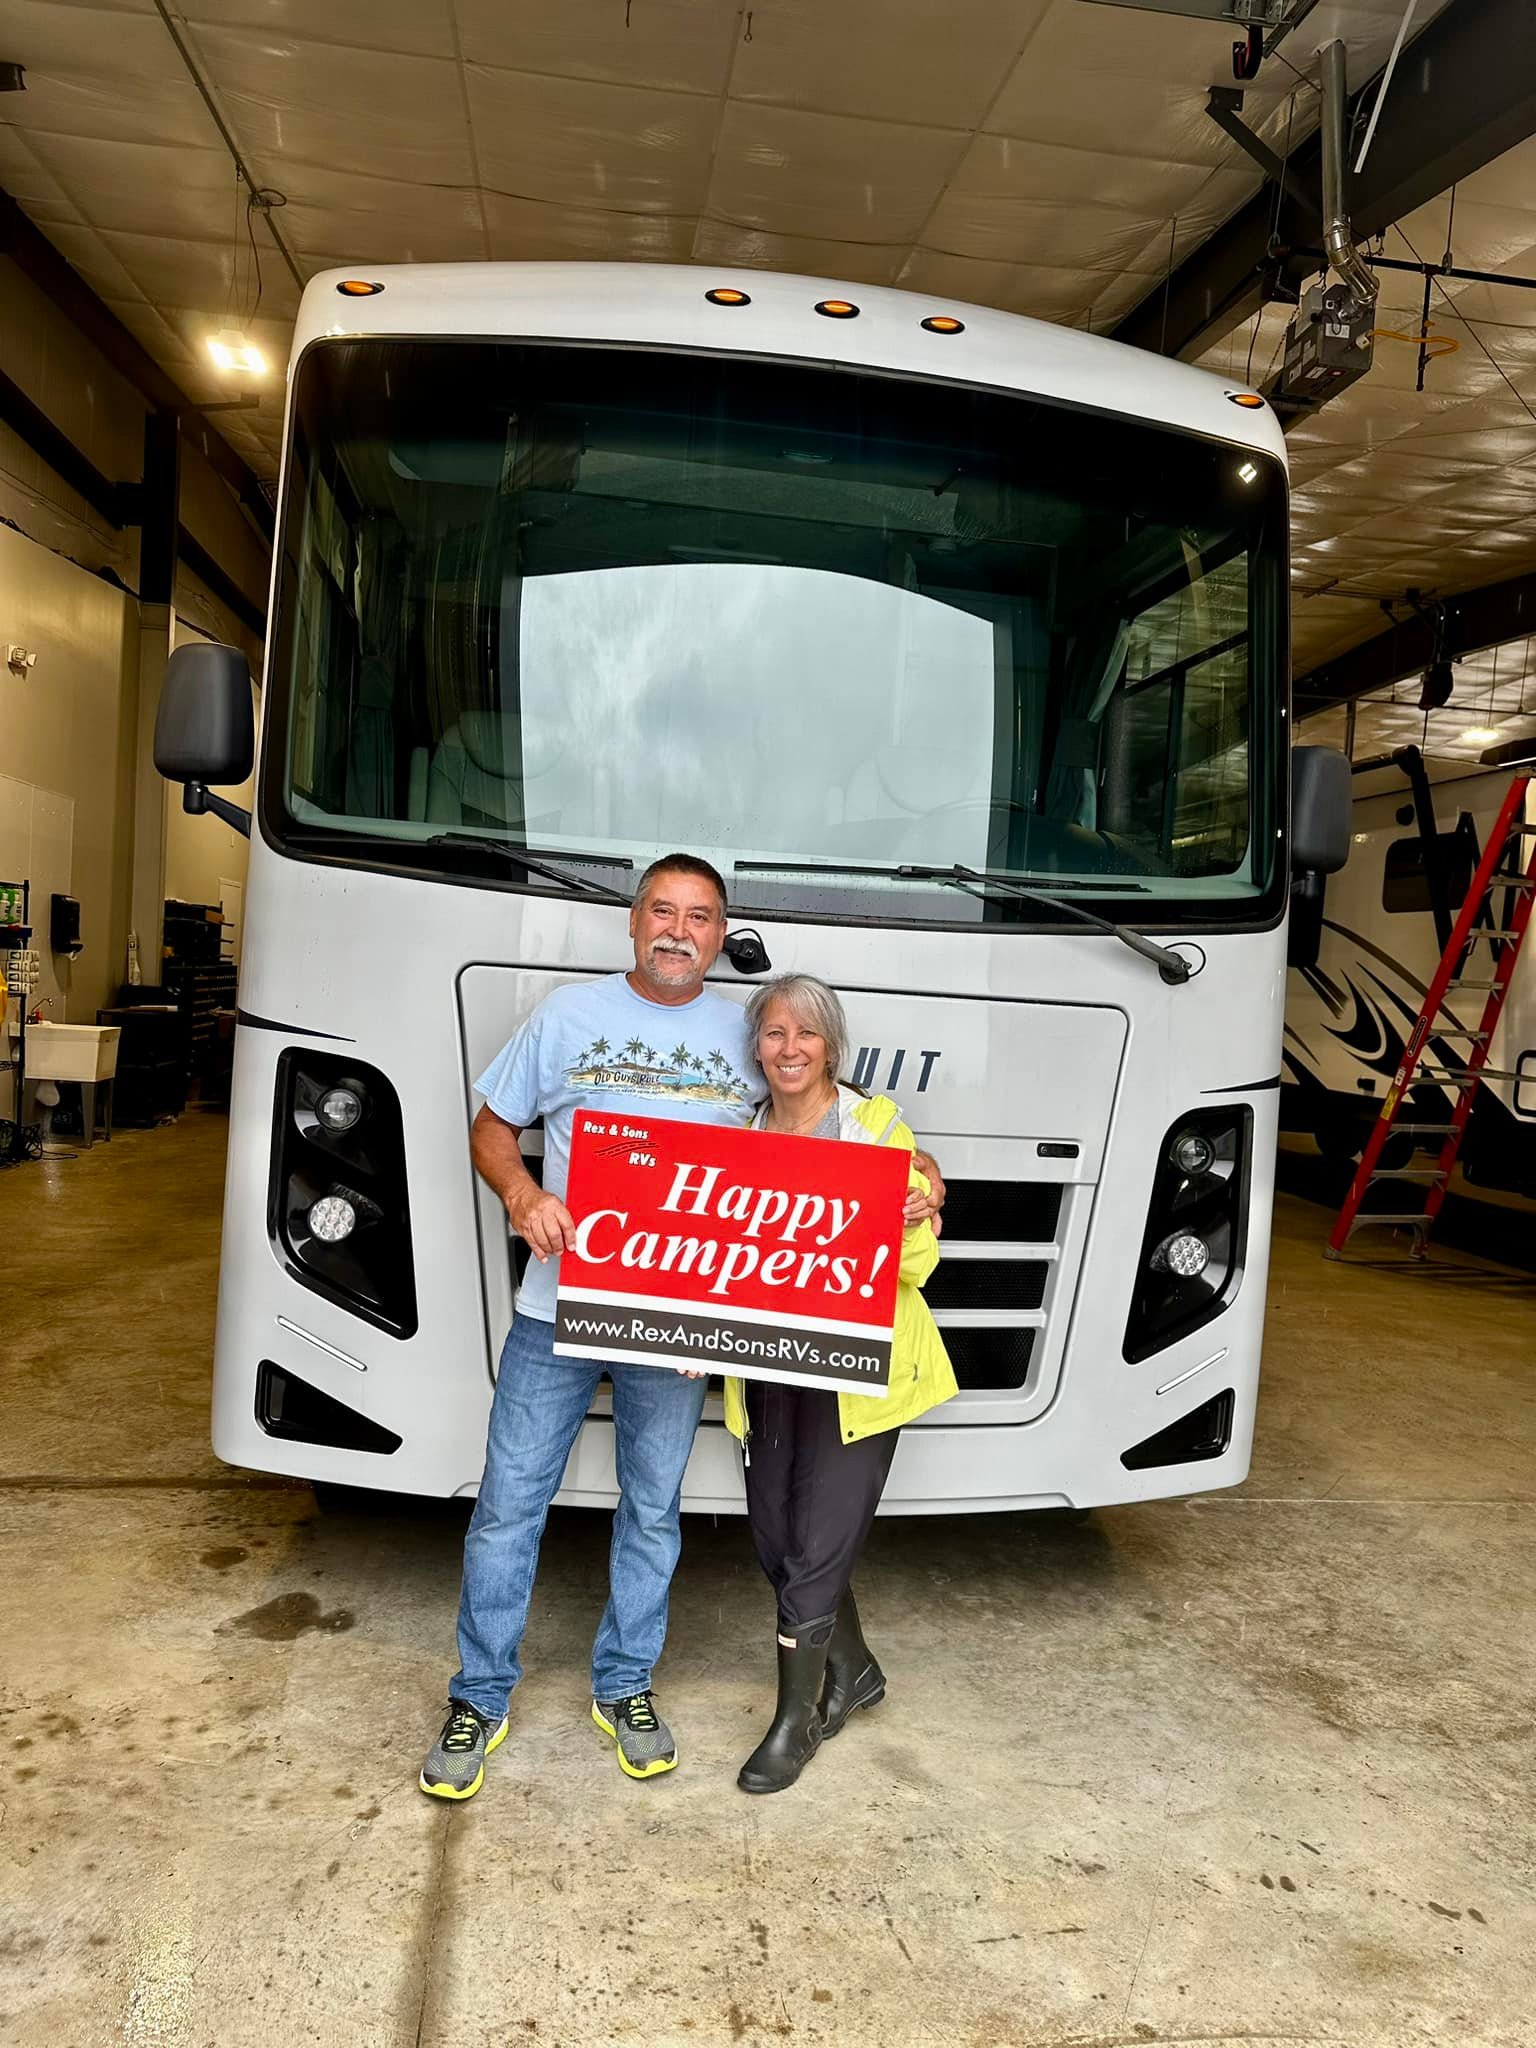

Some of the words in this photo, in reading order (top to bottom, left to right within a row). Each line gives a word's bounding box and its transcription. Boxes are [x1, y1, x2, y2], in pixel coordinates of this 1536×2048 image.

[583, 1121, 605, 1134] Rex
[609, 1124, 618, 1136] &
[621, 1126, 649, 1140] Sons
[628, 1152, 657, 1167] RVs
[657, 1162, 861, 1246] Happy
[575, 1209, 890, 1298] Campers!
[563, 1317, 881, 1373] www.RexAndSonsRVs.com
